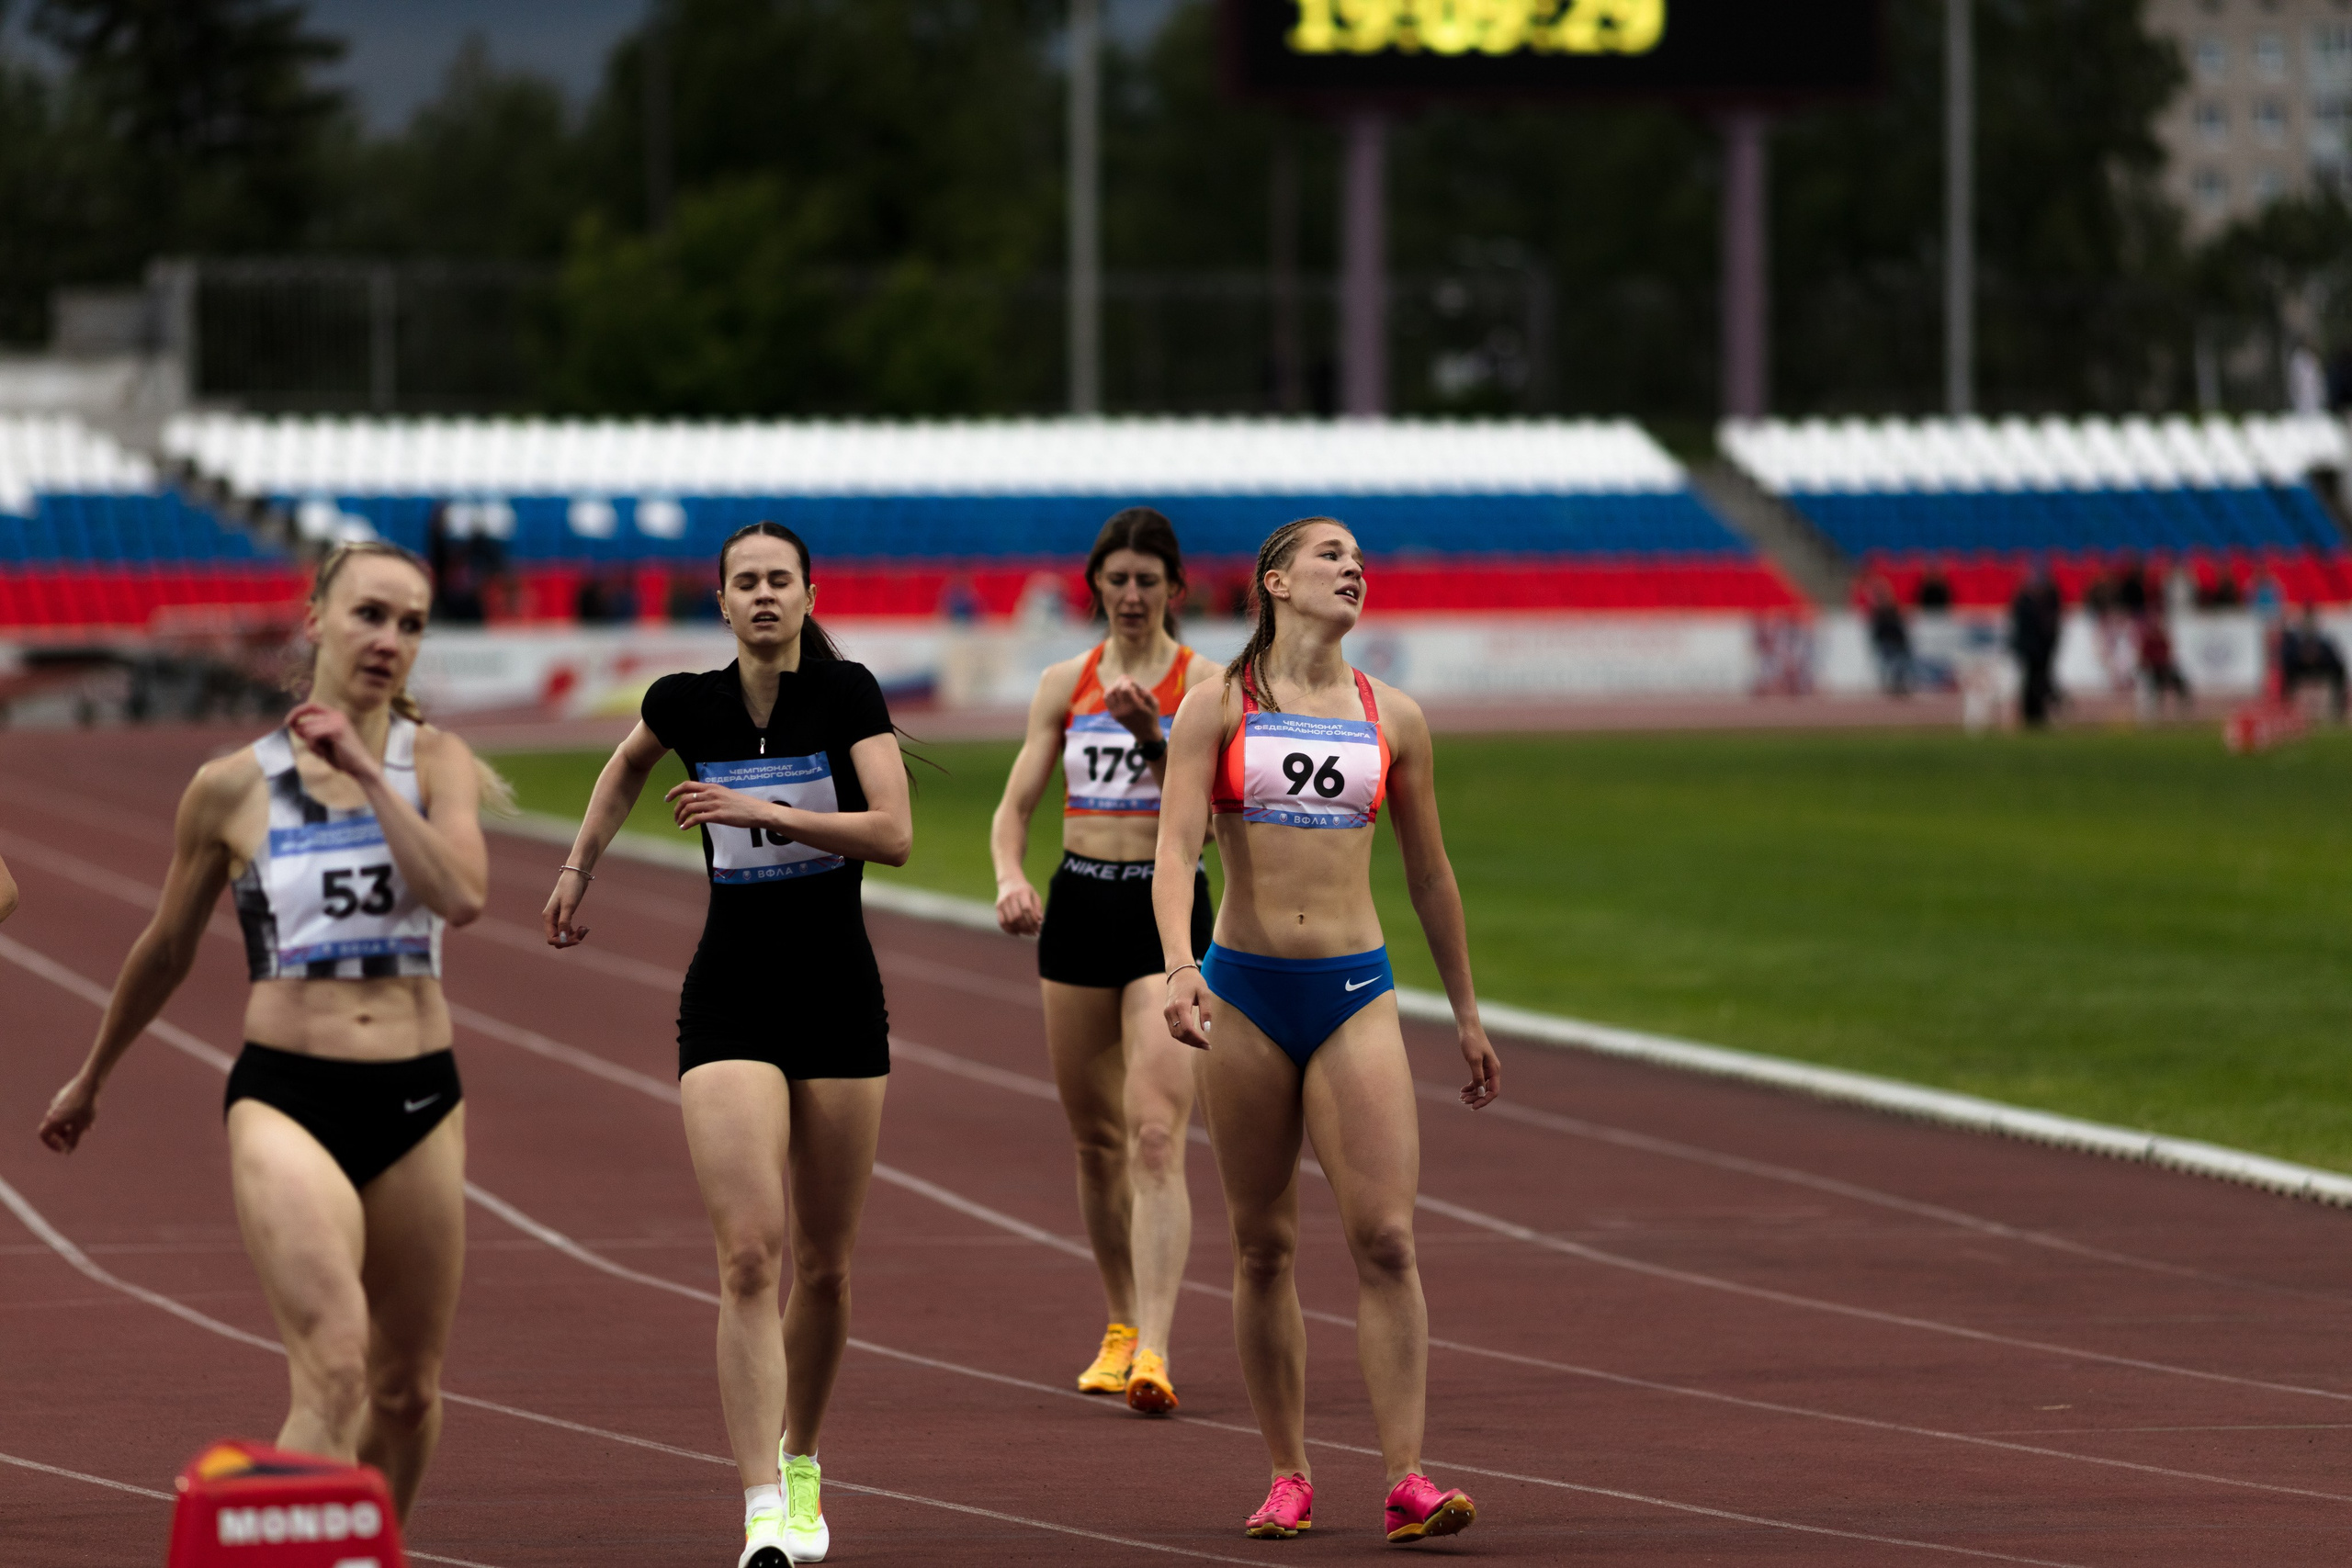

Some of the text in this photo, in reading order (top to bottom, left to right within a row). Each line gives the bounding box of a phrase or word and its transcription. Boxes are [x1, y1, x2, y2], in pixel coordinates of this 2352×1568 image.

[1254, 724, 1371, 739] ФЕДЕРАЛЬНОГО ОКРУГА
[1283, 720, 1343, 730] ЧЕМПИОНАТ
[729, 764, 794, 775] ЧЕМПИОНАТ
[1083, 746, 1147, 784] 179
[705, 766, 823, 784] ФЕДЕРАЛЬНОГО ОКРУГА
[1283, 752, 1345, 798] 96
[1294, 815, 1328, 826] ВФЛА
[757, 866, 794, 878] ВФЛА
[1064, 857, 1155, 881] NIKE PR
[323, 864, 394, 919] 53
[216, 1500, 383, 1547] MONDO
